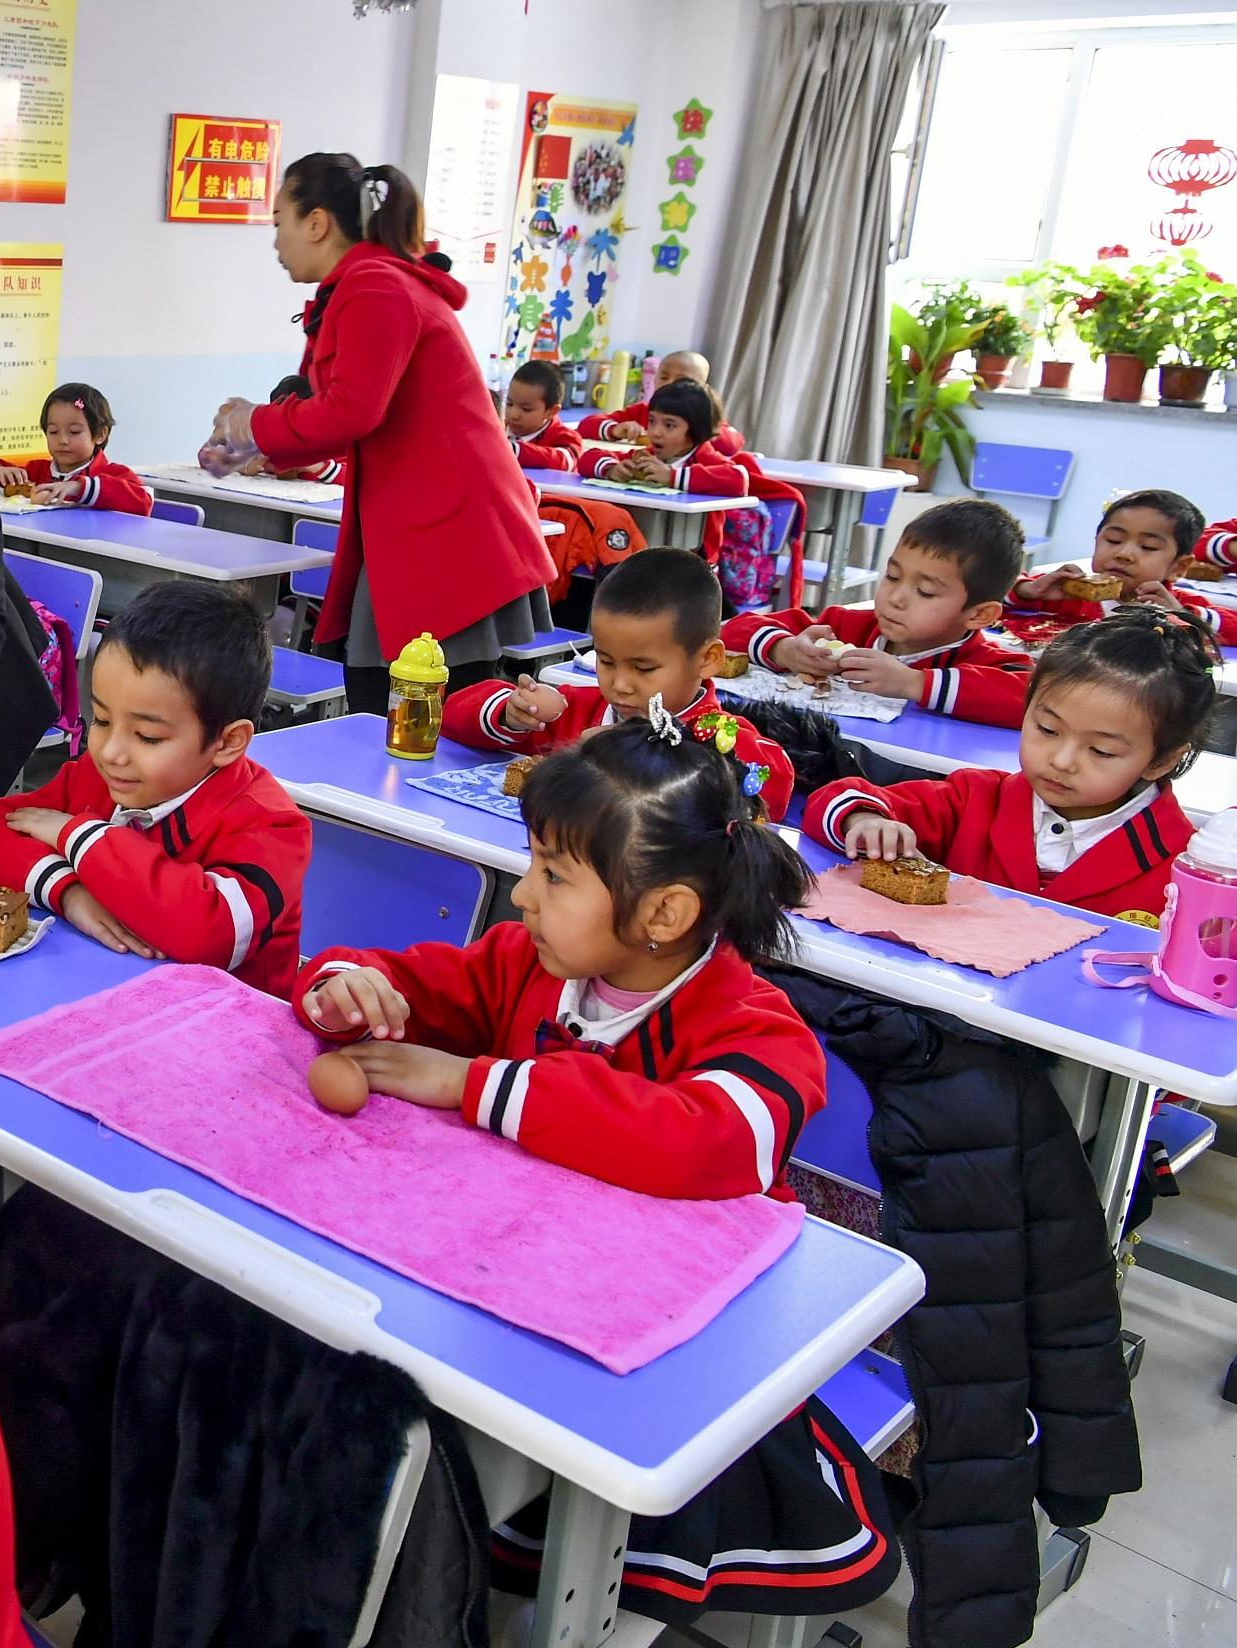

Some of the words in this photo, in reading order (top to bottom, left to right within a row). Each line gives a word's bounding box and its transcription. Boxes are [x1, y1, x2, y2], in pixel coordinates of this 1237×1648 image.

[208, 138, 270, 161] 有电危险
[204, 175, 266, 199] 禁止触摸
